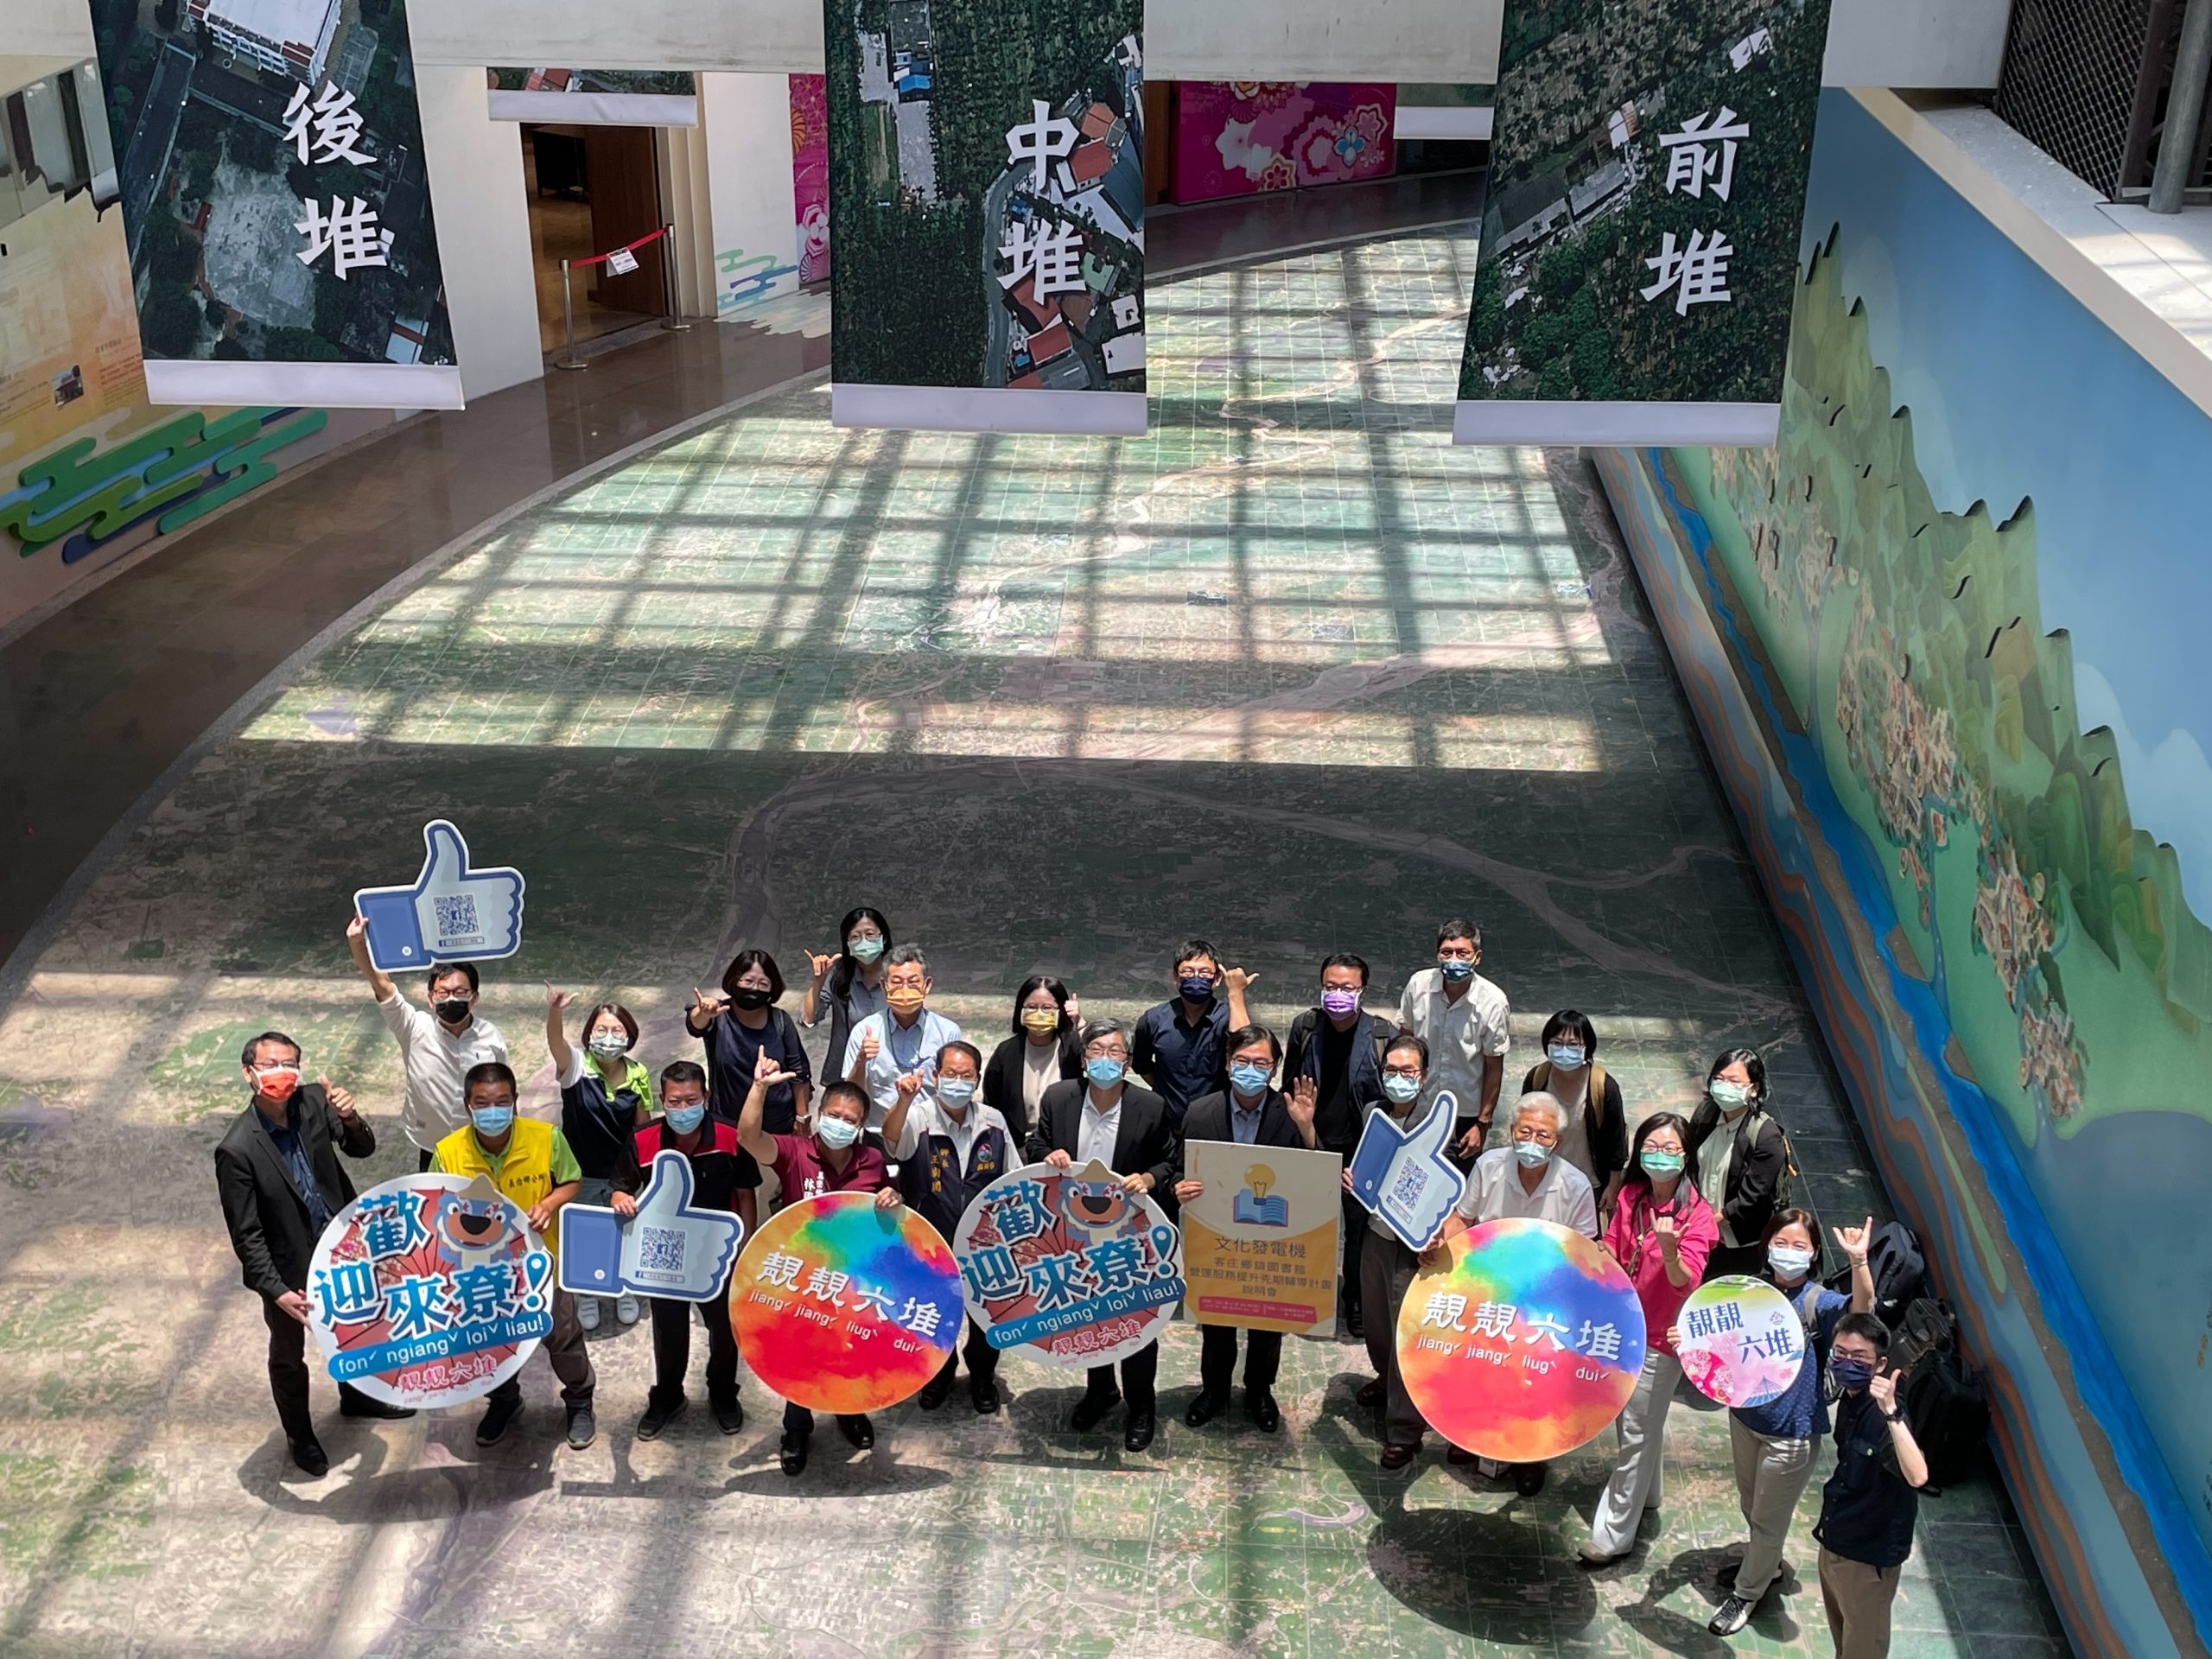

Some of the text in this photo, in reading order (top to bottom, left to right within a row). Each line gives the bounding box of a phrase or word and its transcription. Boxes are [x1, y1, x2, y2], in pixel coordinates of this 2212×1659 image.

[283, 81, 395, 280] 後堆
[997, 99, 1087, 304] 中堆
[1640, 105, 1750, 316] 前堆
[356, 1191, 430, 1257] 歡
[984, 1179, 1055, 1243] 歡
[1215, 1236, 1306, 1259] 文化發電機
[756, 1249, 942, 1338] 靚靚六堆
[1142, 1281, 1180, 1303] liau!
[1685, 1301, 1744, 1338] 靚靚
[505, 1316, 543, 1338] liau!
[1421, 1290, 1623, 1363] 靚靚六堆
[1737, 1327, 1795, 1363] 六堆
